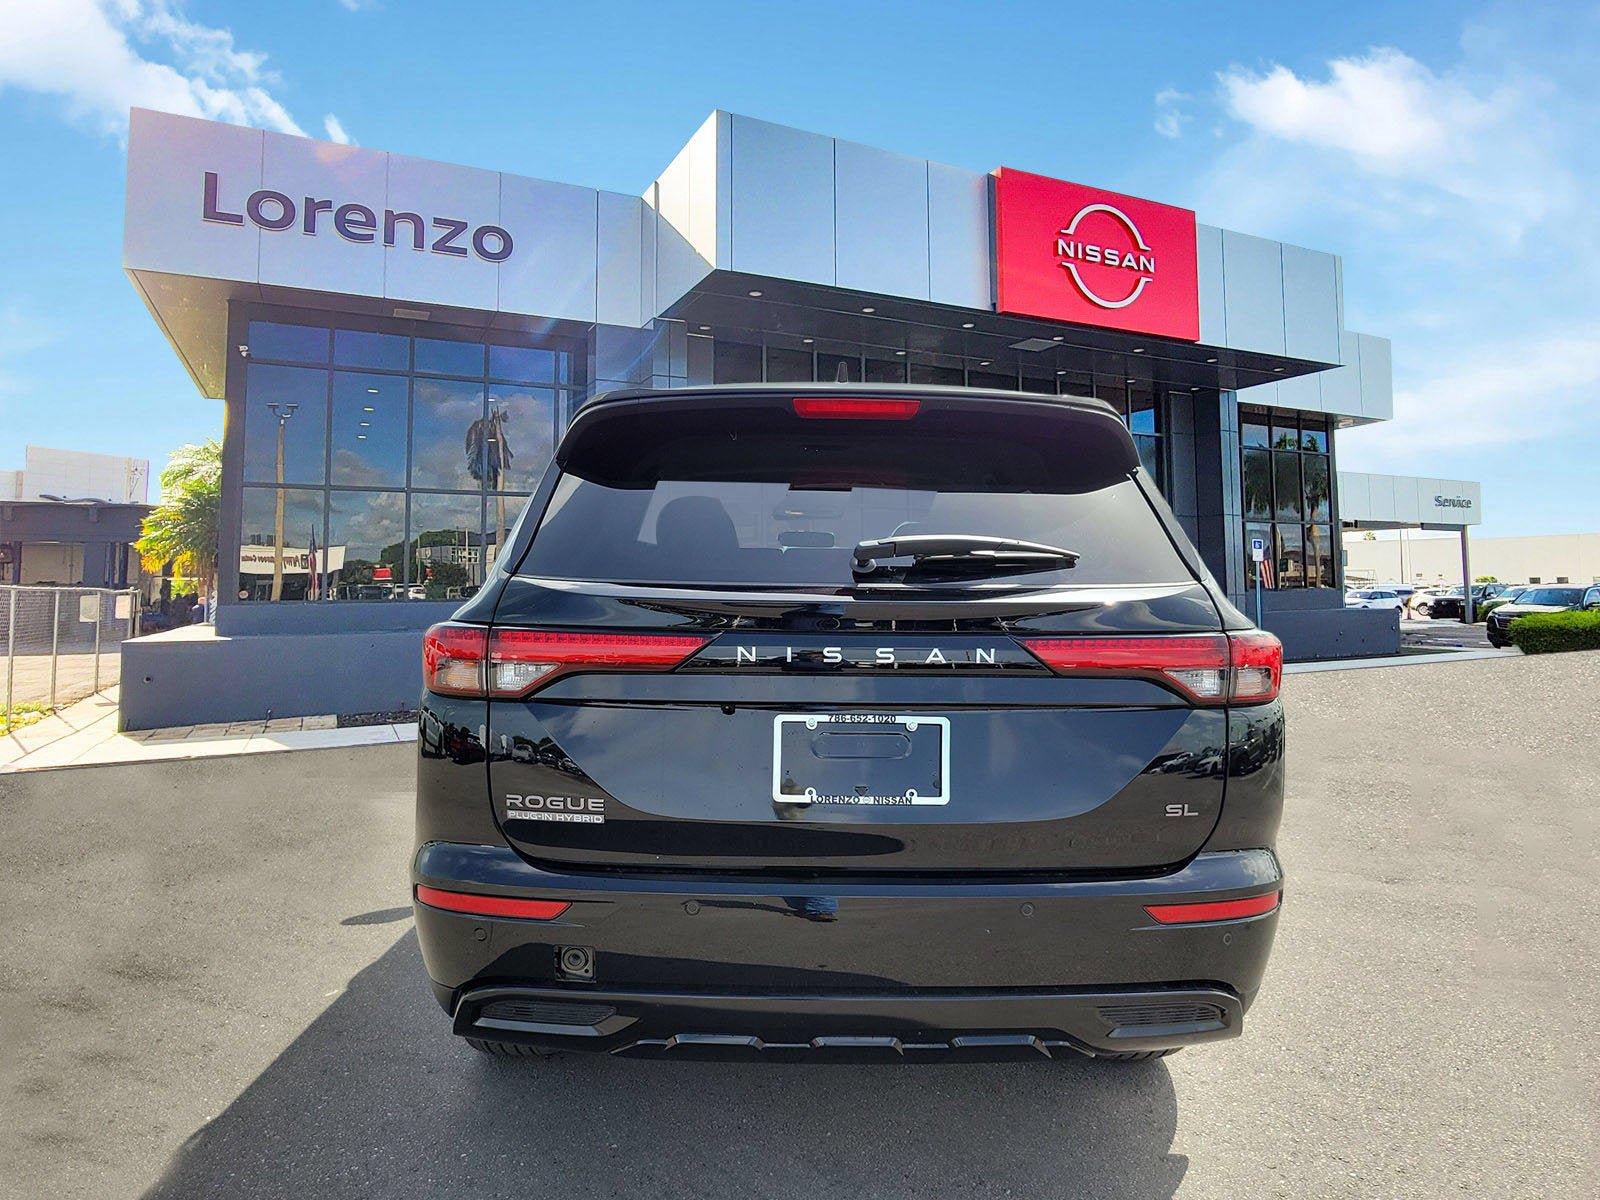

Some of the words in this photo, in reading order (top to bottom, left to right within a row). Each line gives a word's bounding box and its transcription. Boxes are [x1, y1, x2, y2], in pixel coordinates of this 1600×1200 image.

[203, 171, 514, 262] Lorenzo
[1057, 238, 1155, 273] NISSAN
[1434, 495, 1472, 509] Service
[736, 646, 996, 664] NISSAN
[828, 714, 897, 724] 786-652-1020
[506, 794, 605, 811] ROGUE
[811, 795, 861, 805] LORENZO
[873, 796, 913, 806] NISSAN
[1165, 803, 1199, 817] SL
[508, 811, 553, 821] PLUG-IN
[556, 813, 604, 824] HYBRID
